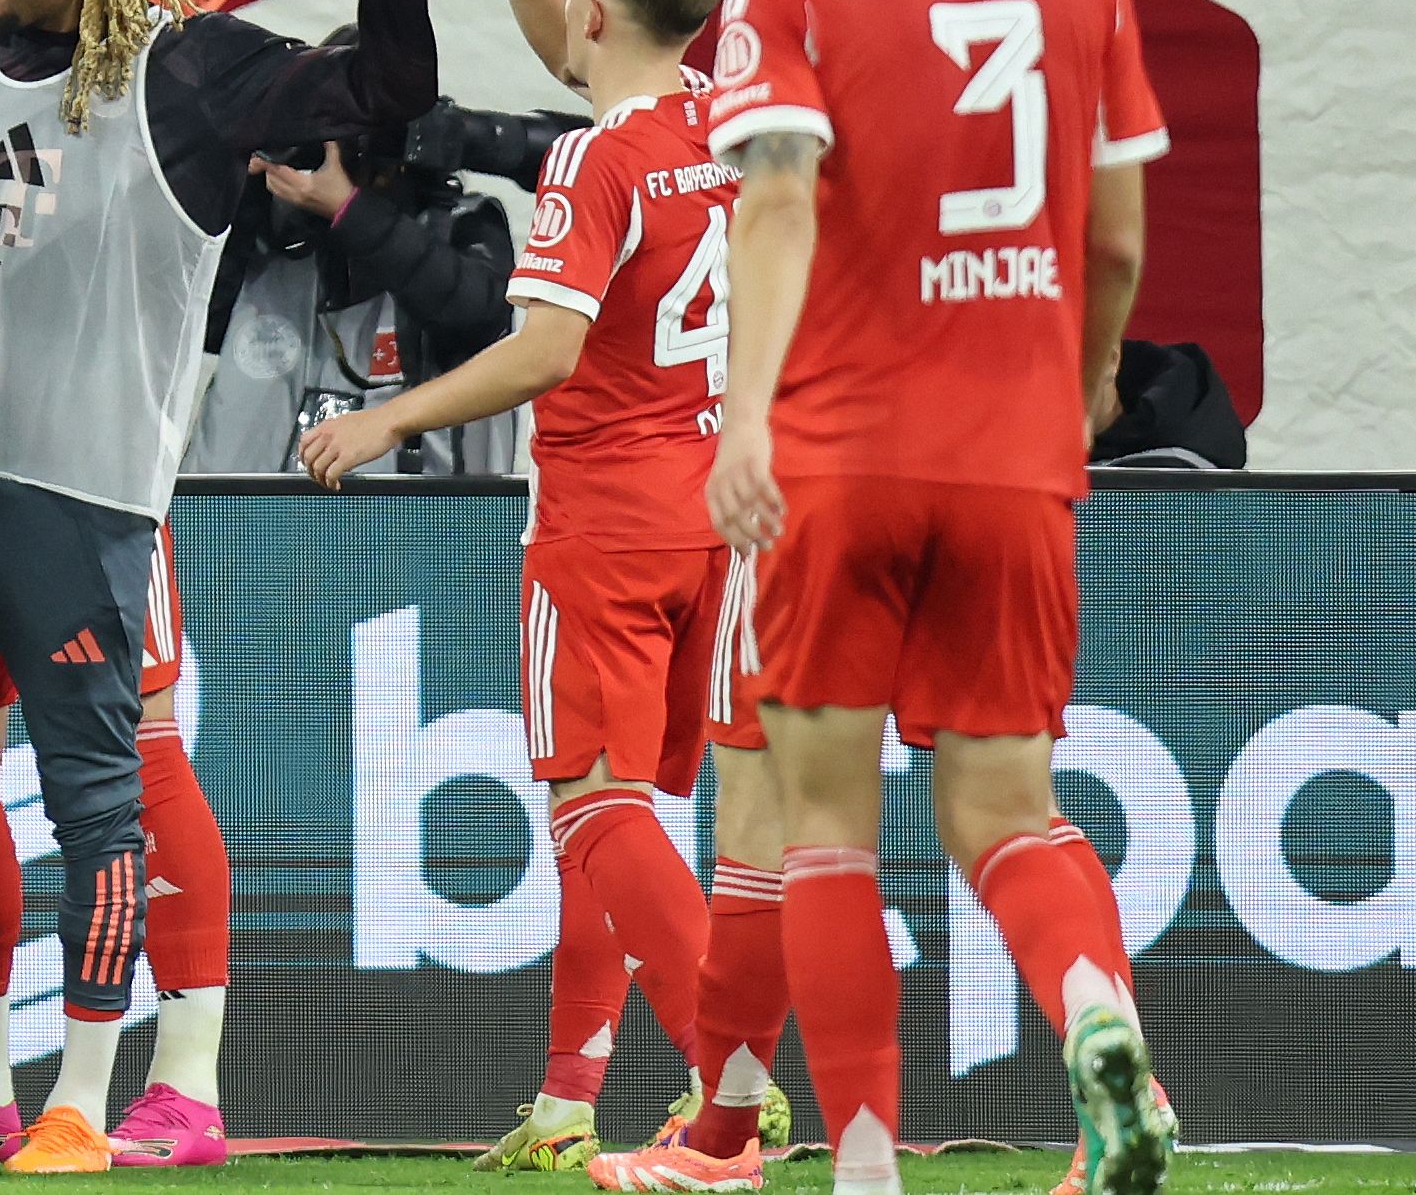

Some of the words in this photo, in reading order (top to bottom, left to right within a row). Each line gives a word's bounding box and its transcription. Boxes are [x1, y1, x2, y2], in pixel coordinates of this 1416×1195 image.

[646, 170, 673, 199] FC
[516, 252, 564, 273] llianz
[920, 247, 1063, 304] MINJAE
[653, 198, 742, 397] 4
